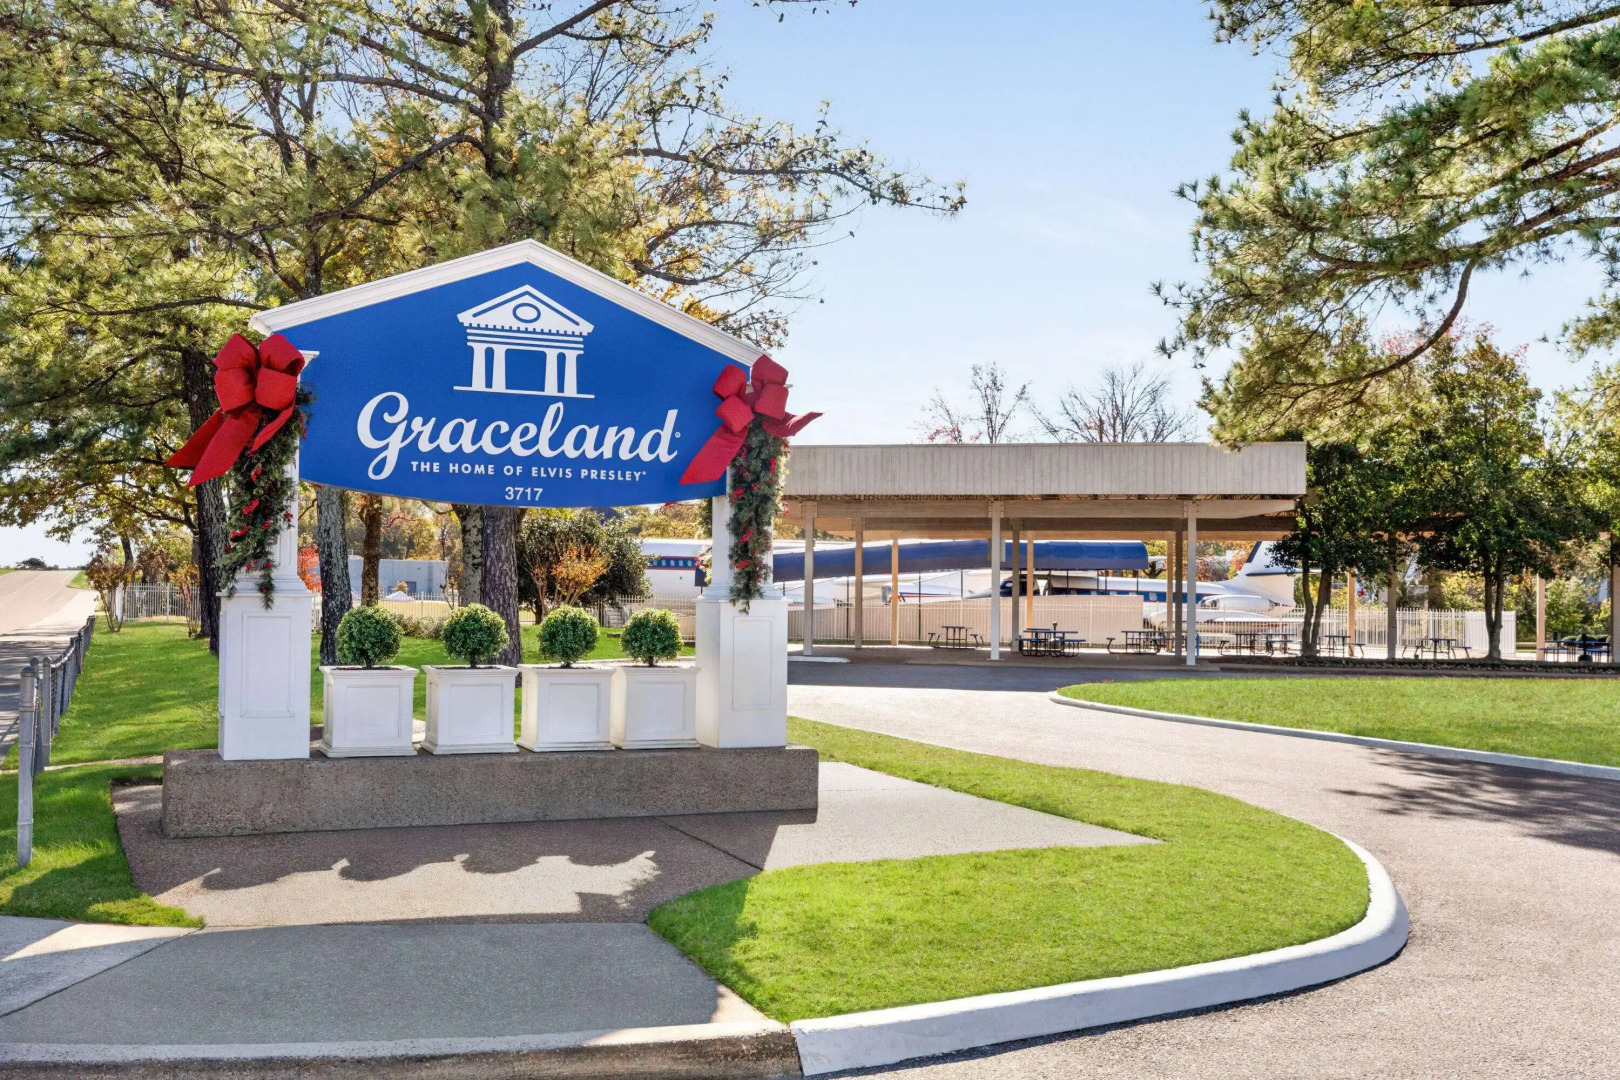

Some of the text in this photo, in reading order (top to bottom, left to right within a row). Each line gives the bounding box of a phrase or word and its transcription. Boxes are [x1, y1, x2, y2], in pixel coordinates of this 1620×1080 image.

[410, 461, 440, 473] THE
[449, 463, 495, 475] HOME
[503, 466, 523, 476] OF
[531, 467, 573, 479] ELVIS
[504, 486, 543, 501] 3717
